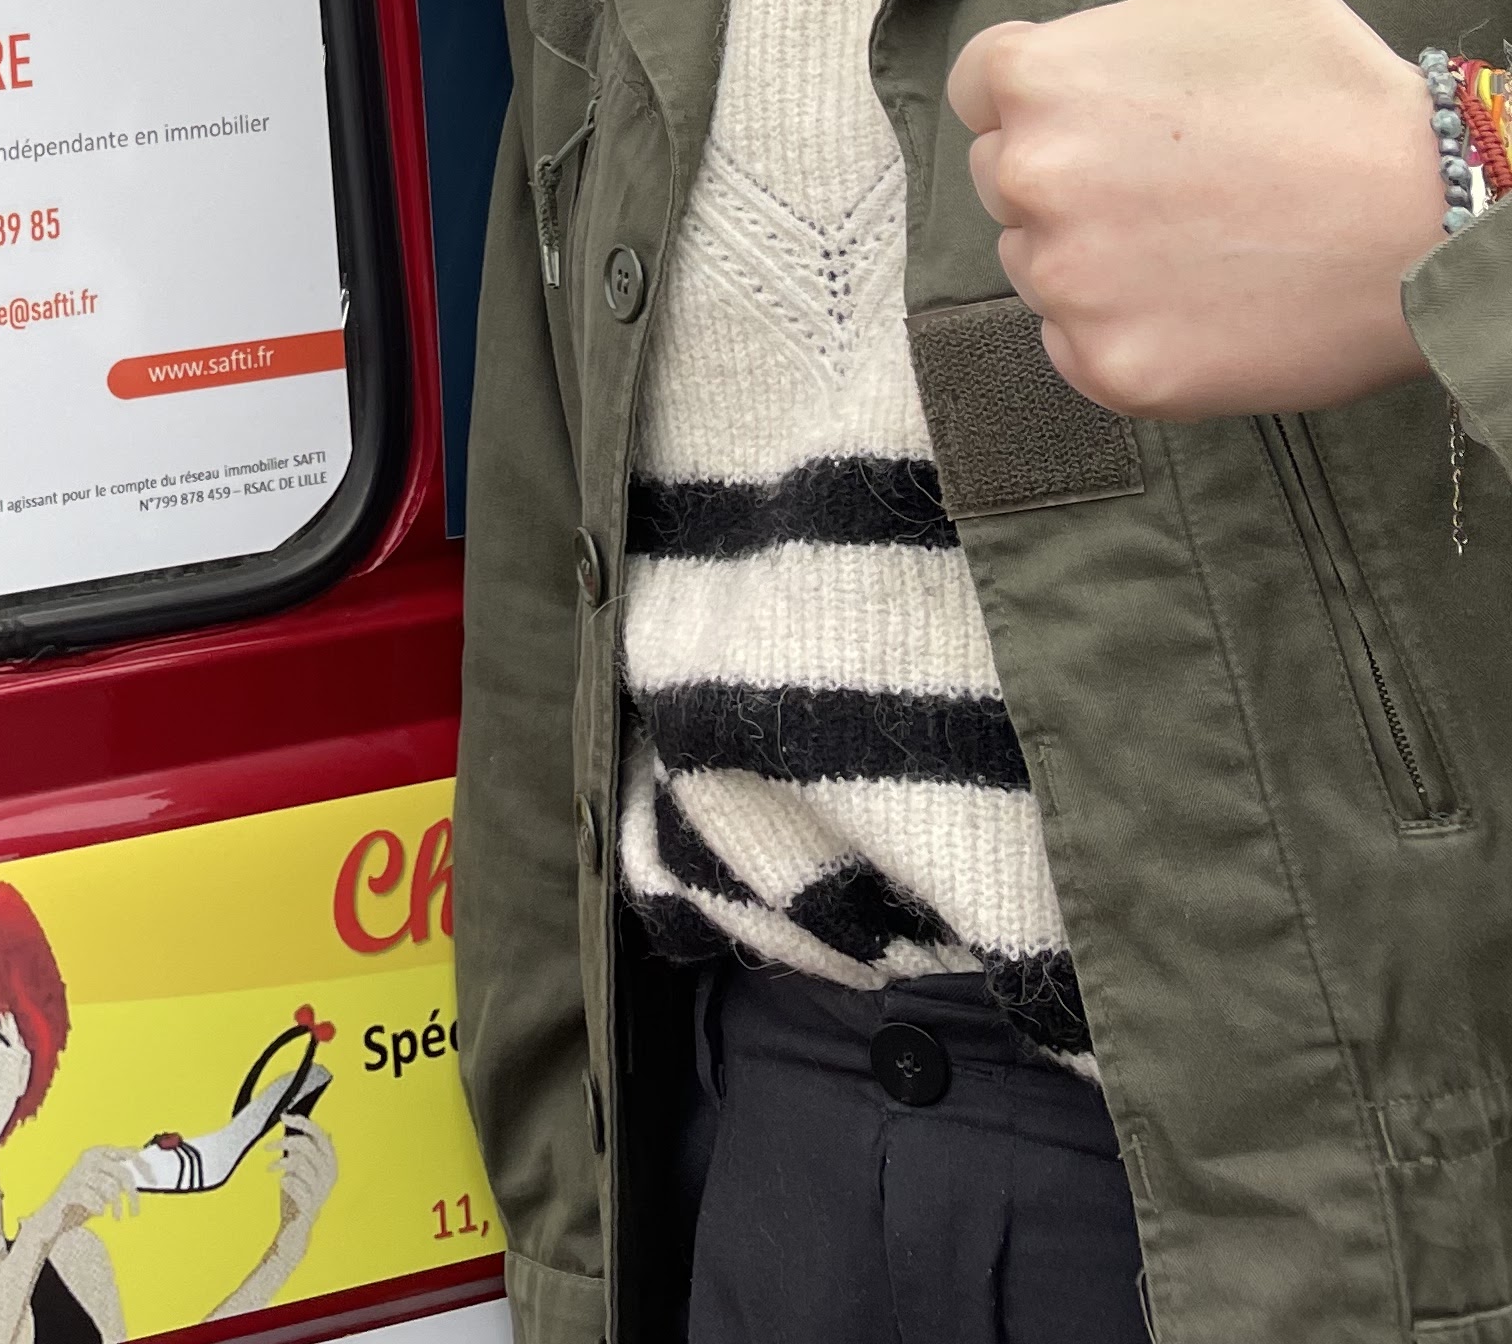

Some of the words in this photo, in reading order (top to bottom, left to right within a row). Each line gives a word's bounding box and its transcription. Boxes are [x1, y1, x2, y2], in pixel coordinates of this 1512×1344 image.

[134, 128, 159, 146] en
[164, 114, 270, 143] immobilier
[30, 207, 61, 242] 85
[147, 346, 275, 384] www.safti.fr
[7, 491, 59, 513] agissant
[61, 487, 93, 506] pour
[95, 484, 108, 498] le
[109, 476, 159, 496] compte
[160, 472, 178, 488] du
[179, 467, 221, 485] réseau
[223, 457, 291, 479] immobilier
[292, 450, 328, 467] SAFTI
[180, 490, 206, 507] 878
[207, 486, 232, 502] 459
[243, 478, 276, 496] RSAC
[278, 475, 296, 490] DE
[297, 471, 328, 488] LILLE
[431, 1193, 490, 1240] 11,
